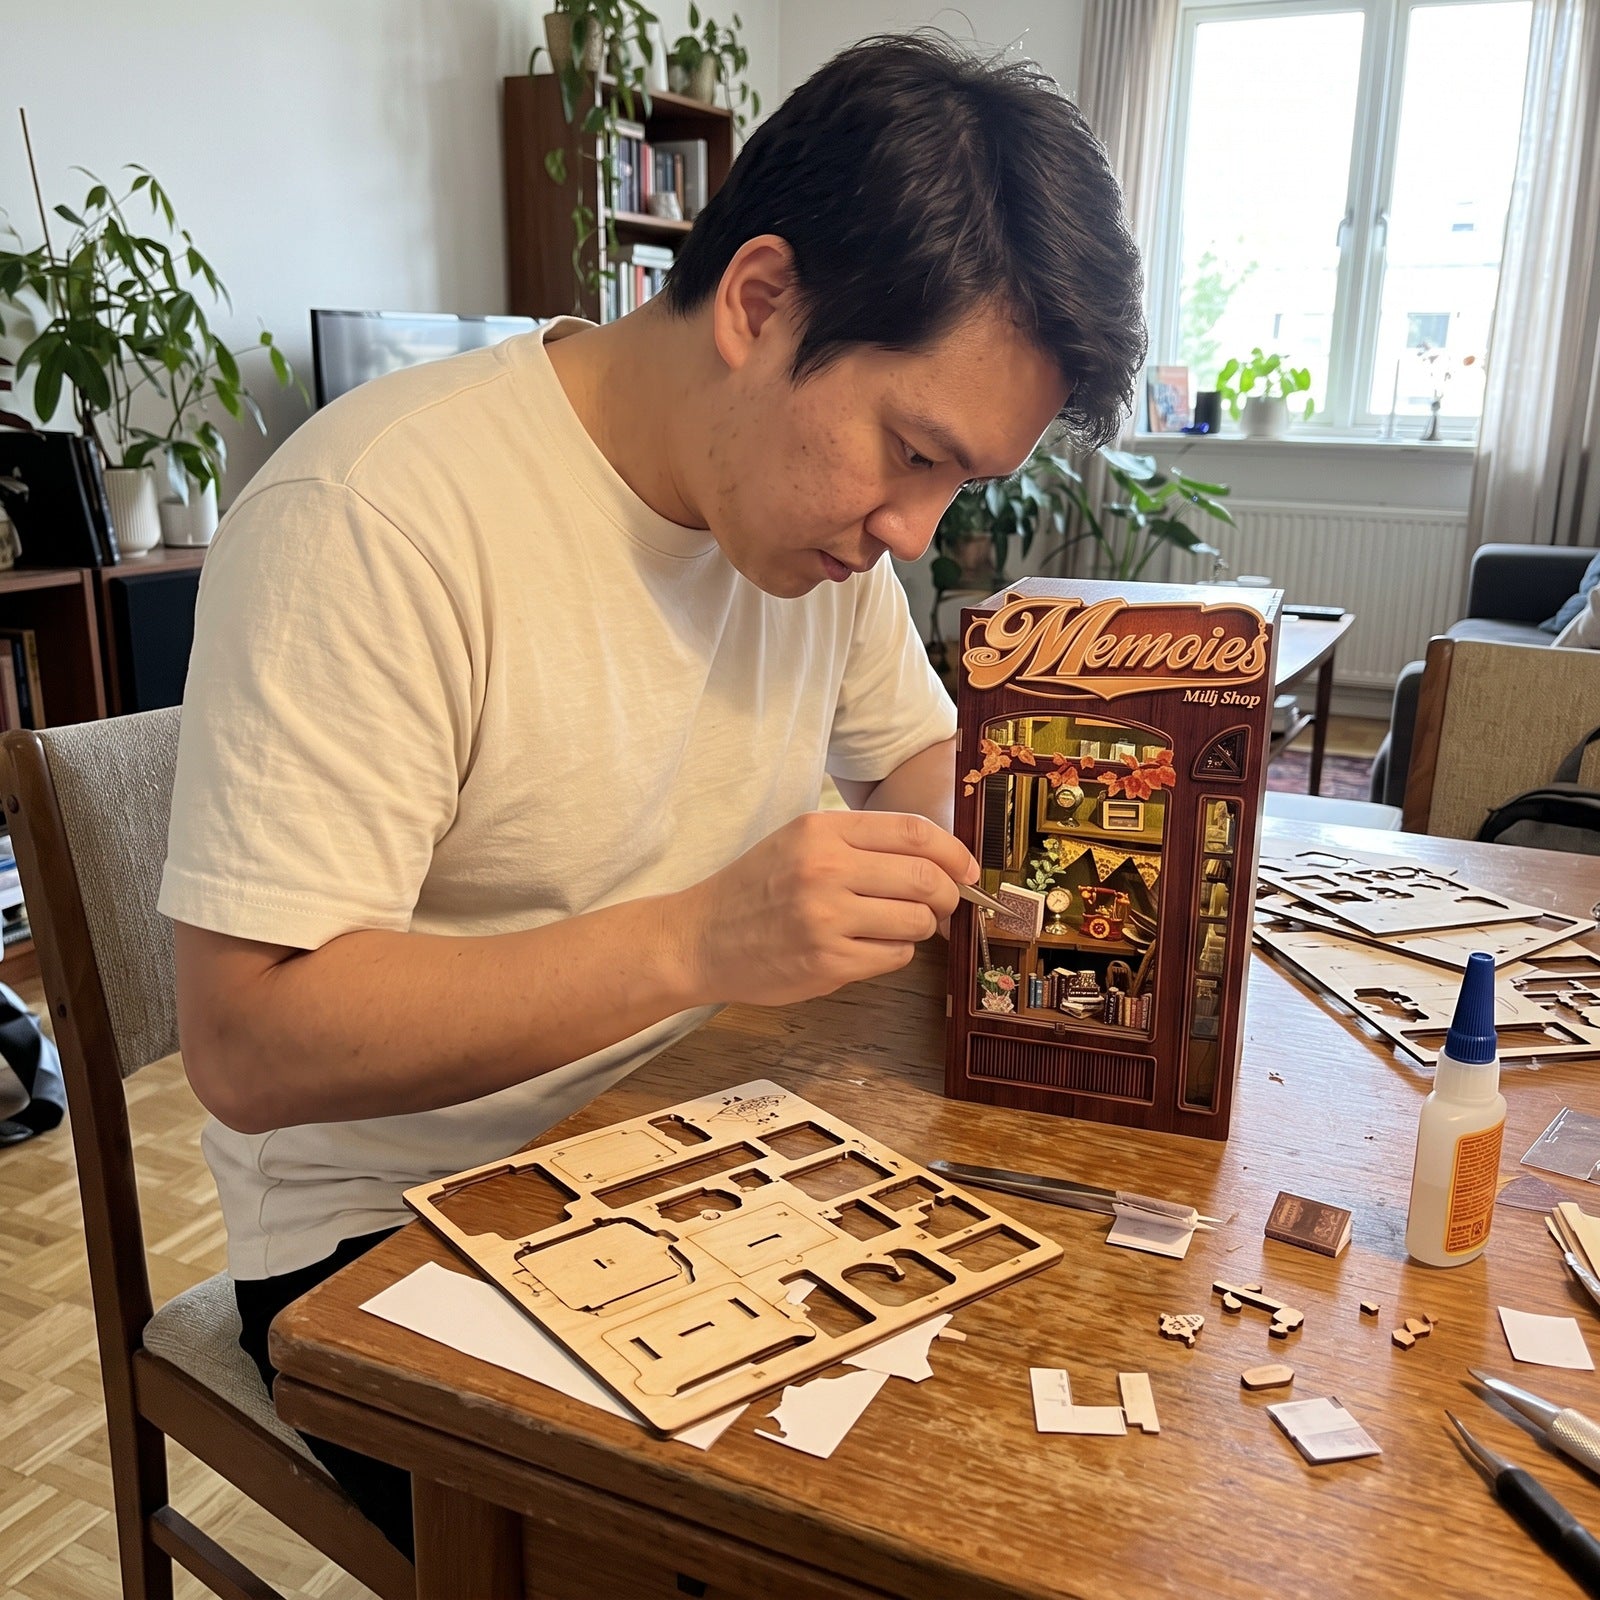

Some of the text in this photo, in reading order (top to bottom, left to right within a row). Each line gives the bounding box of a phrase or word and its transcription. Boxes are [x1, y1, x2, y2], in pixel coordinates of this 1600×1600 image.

[962, 597, 1268, 689] Memoies
[1182, 689, 1261, 709] Millj Shop
